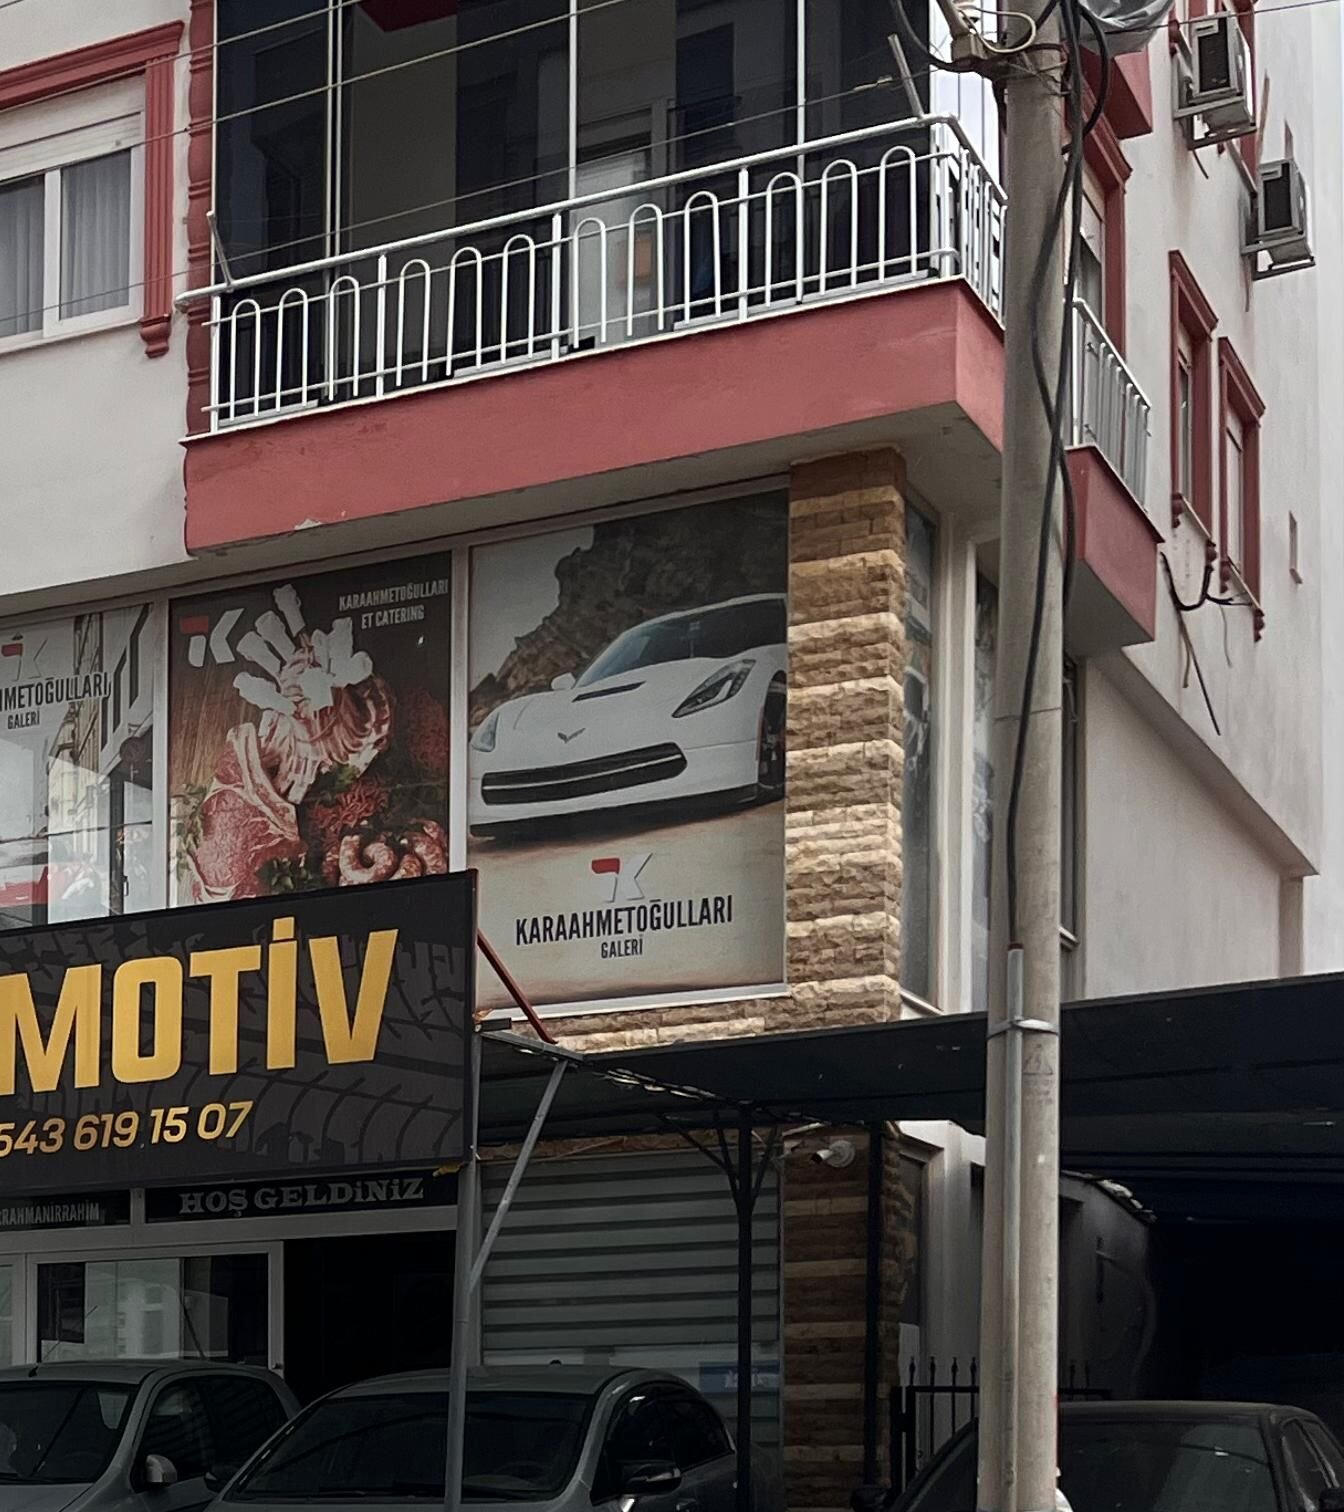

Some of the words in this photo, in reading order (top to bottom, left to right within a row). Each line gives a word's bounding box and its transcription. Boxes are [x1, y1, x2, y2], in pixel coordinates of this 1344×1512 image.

[361, 613, 374, 630] ET
[375, 604, 425, 627] CATERING
[515, 894, 733, 946] KARAAHMETOĞULLARI
[73, 1110, 140, 1151] 619
[150, 1105, 190, 1144] 15
[196, 1100, 244, 1140] 07
[178, 1189, 249, 1217] HOŞ
